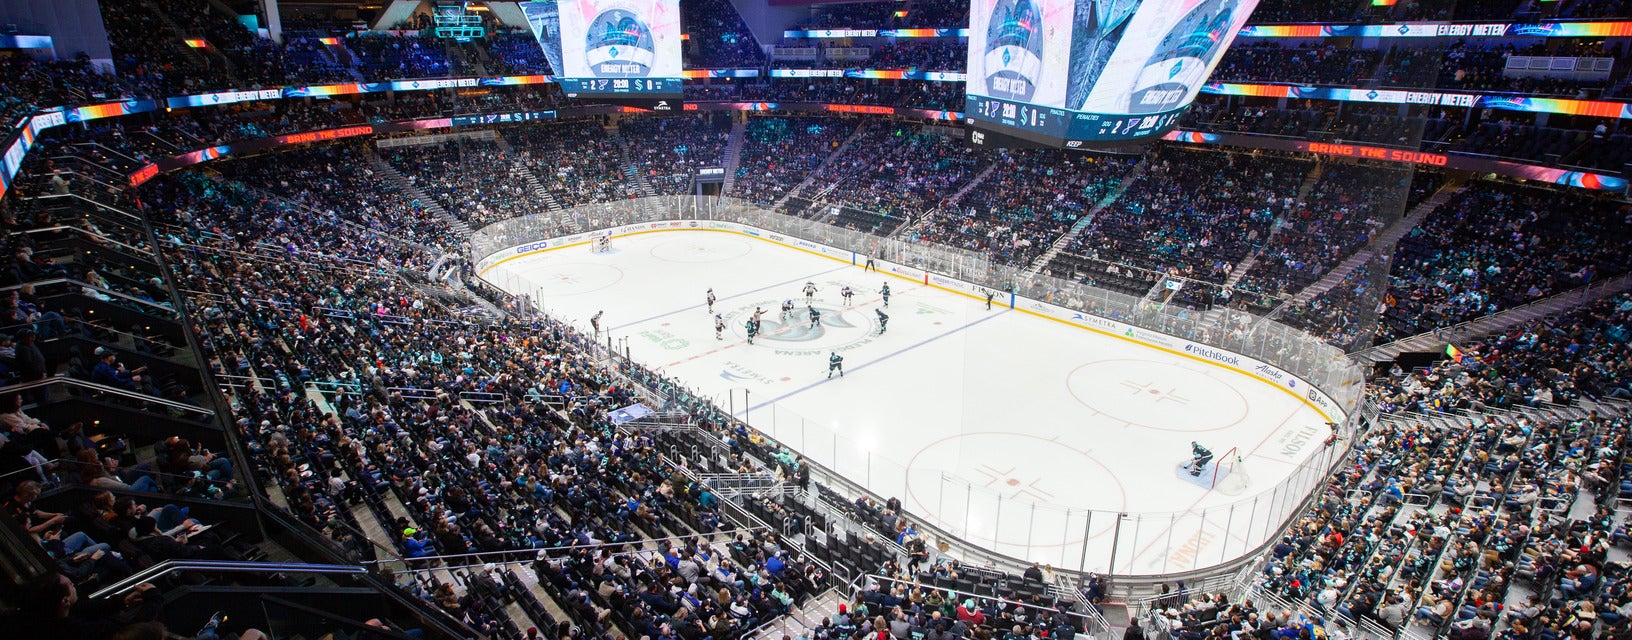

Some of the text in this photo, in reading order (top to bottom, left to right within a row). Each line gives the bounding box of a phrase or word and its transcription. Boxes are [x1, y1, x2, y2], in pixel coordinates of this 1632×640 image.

[1438, 24, 1471, 36] ENERGY
[1472, 24, 1505, 35] METER
[601, 64, 620, 73] ENERGY
[590, 80, 596, 90] 2
[613, 79, 629, 88] 20:00
[647, 80, 652, 90] 0
[993, 77, 1010, 92] ENERGY
[236, 89, 279, 101] ENERGY METER
[1407, 92, 1442, 105] ENERGY
[1442, 94, 1474, 107] METER
[829, 104, 895, 114] BRING THE SOUND
[985, 101, 989, 116] 2
[1031, 109, 1037, 126] 0
[1111, 120, 1122, 134] 2
[286, 126, 373, 144] BRING THE SOUND
[1308, 142, 1447, 166] BRING THE SOUND
[516, 241, 547, 254] GEICO
[1084, 316, 1116, 329] SYMETRA
[1193, 346, 1239, 366] PitchBook
[1255, 364, 1284, 379] Alaska
[1281, 426, 1318, 457] FILSON
